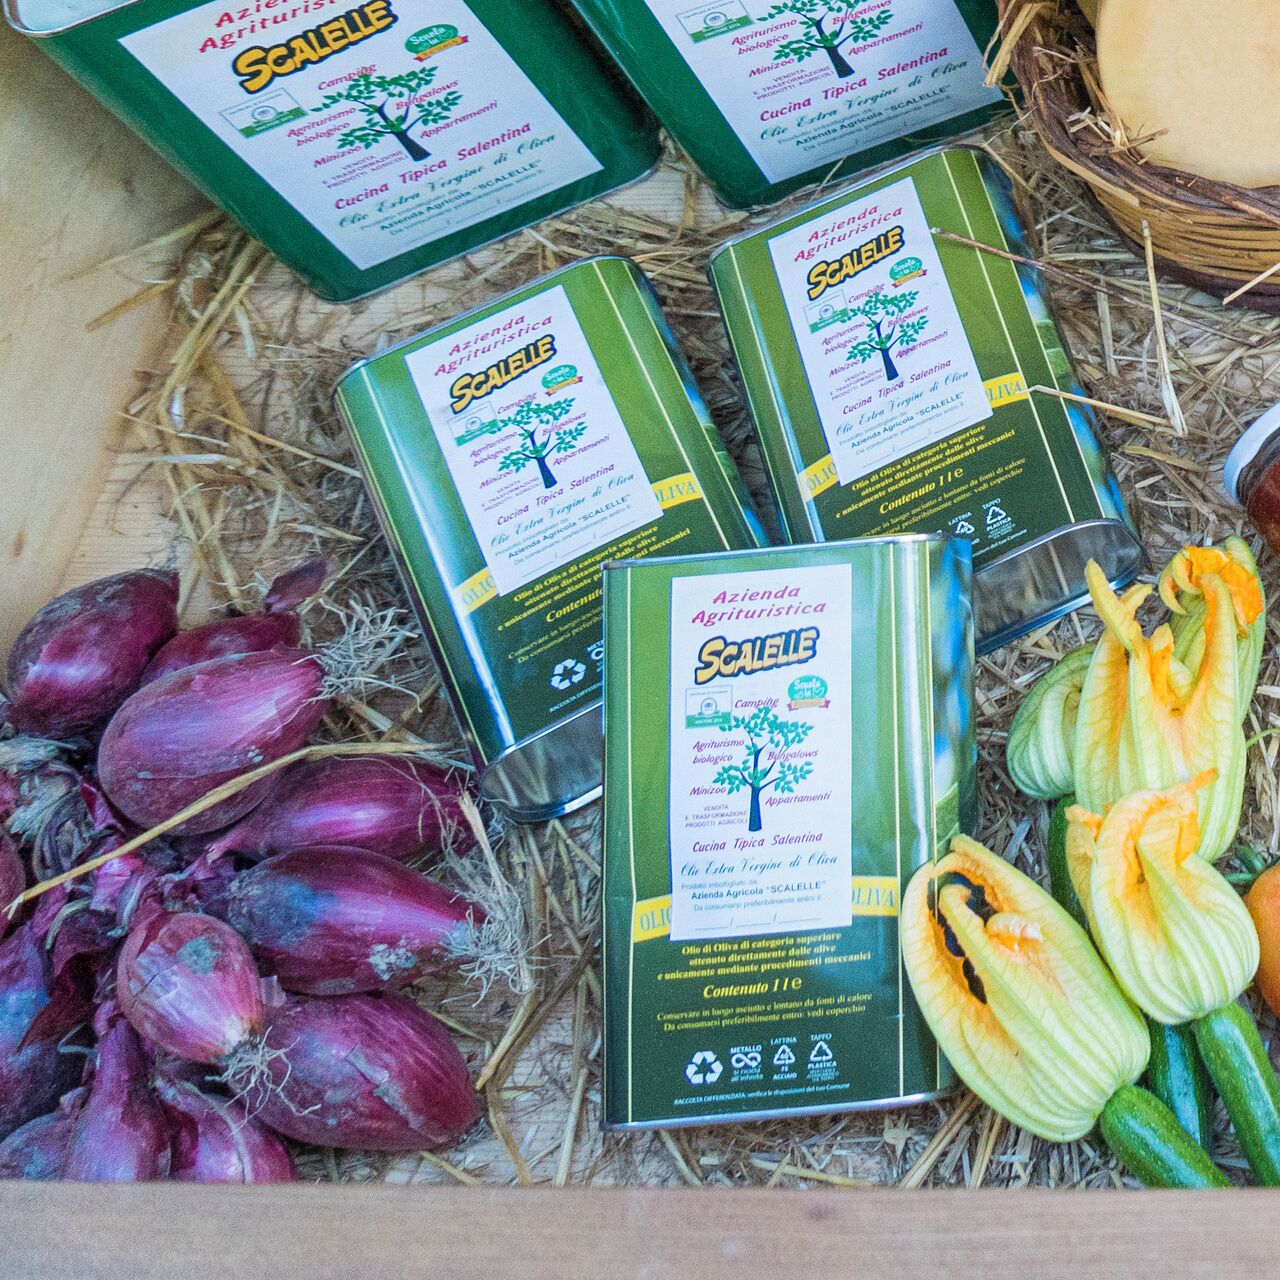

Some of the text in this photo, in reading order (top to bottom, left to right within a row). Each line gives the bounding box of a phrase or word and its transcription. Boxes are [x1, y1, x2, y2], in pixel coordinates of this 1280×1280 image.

[406, 27, 446, 44] Scuola
[731, 19, 797, 45] Agriturismo
[737, 33, 789, 55] biologico
[848, 20, 923, 55] Appartamenti
[317, 64, 376, 90] Camping
[748, 56, 794, 77] Minizoo
[395, 80, 458, 110] Bungalows
[759, 47, 947, 121] Cucina Tipica Salentina
[794, 107, 838, 128] Extra
[844, 84, 900, 111] Vergine
[931, 60, 967, 77] Oliva
[286, 107, 356, 137] Agriturismo
[419, 99, 497, 138] Appartamenti
[795, 128, 837, 146] Azienda
[839, 111, 883, 130] Agricola
[296, 122, 350, 146] biologico
[313, 144, 361, 167] Minizoo
[334, 122, 530, 209] Cucina Tipica Salentina
[374, 189, 421, 213] Extra
[426, 165, 483, 191] Vergine
[516, 134, 555, 154] Oliva
[380, 210, 424, 230] Azienda
[425, 191, 471, 212] Agricola
[807, 205, 878, 242] Azienda
[793, 207, 902, 262] Agrituristica
[806, 224, 905, 301] SCALELLE
[433, 315, 551, 376] Agrituristica
[448, 315, 524, 356] Azienda
[449, 333, 557, 415] SCALELLE
[842, 359, 951, 414] Cucina Tipica Salentina
[851, 431, 881, 448] Azienda
[882, 415, 914, 433] Agricola
[496, 463, 614, 525] Cucina Tipica Salentina
[654, 483, 696, 503] LIVA
[879, 482, 935, 513] Contenuto
[508, 539, 541, 558] Azienda
[542, 521, 576, 541] Agricola
[712, 585, 800, 604] Azienda
[691, 601, 826, 627] Agrituristica
[693, 625, 819, 685] SCALELLE
[734, 697, 779, 709] Camping
[692, 739, 744, 752] Agriturismo
[766, 749, 817, 762] Bungalows
[692, 754, 733, 764] biologico
[689, 783, 726, 795] Minizoo
[764, 792, 830, 807] Appartamenti
[685, 820, 715, 828] PRODOTTI
[692, 833, 823, 852] Cucina Tipica Salentina
[680, 851, 837, 877] Olio Extra Vergine di Oliva
[690, 881, 825, 899] Azienda Agricola "SCALELLE"
[681, 932, 841, 954] Olio di Oliva di categoria superiore
[689, 944, 835, 965] ottenuto direttamente dalle olive
[664, 968, 714, 979] unicamente
[717, 963, 758, 975] mediante
[760, 955, 822, 972] procedimenti
[824, 950, 870, 964] meccanici
[703, 982, 768, 998] Contenuto
[730, 1044, 761, 1053] METALLO
[770, 1036, 796, 1045] LATTINA
[810, 1032, 832, 1041] TAPPO
[807, 1060, 836, 1069] PLASTICA
